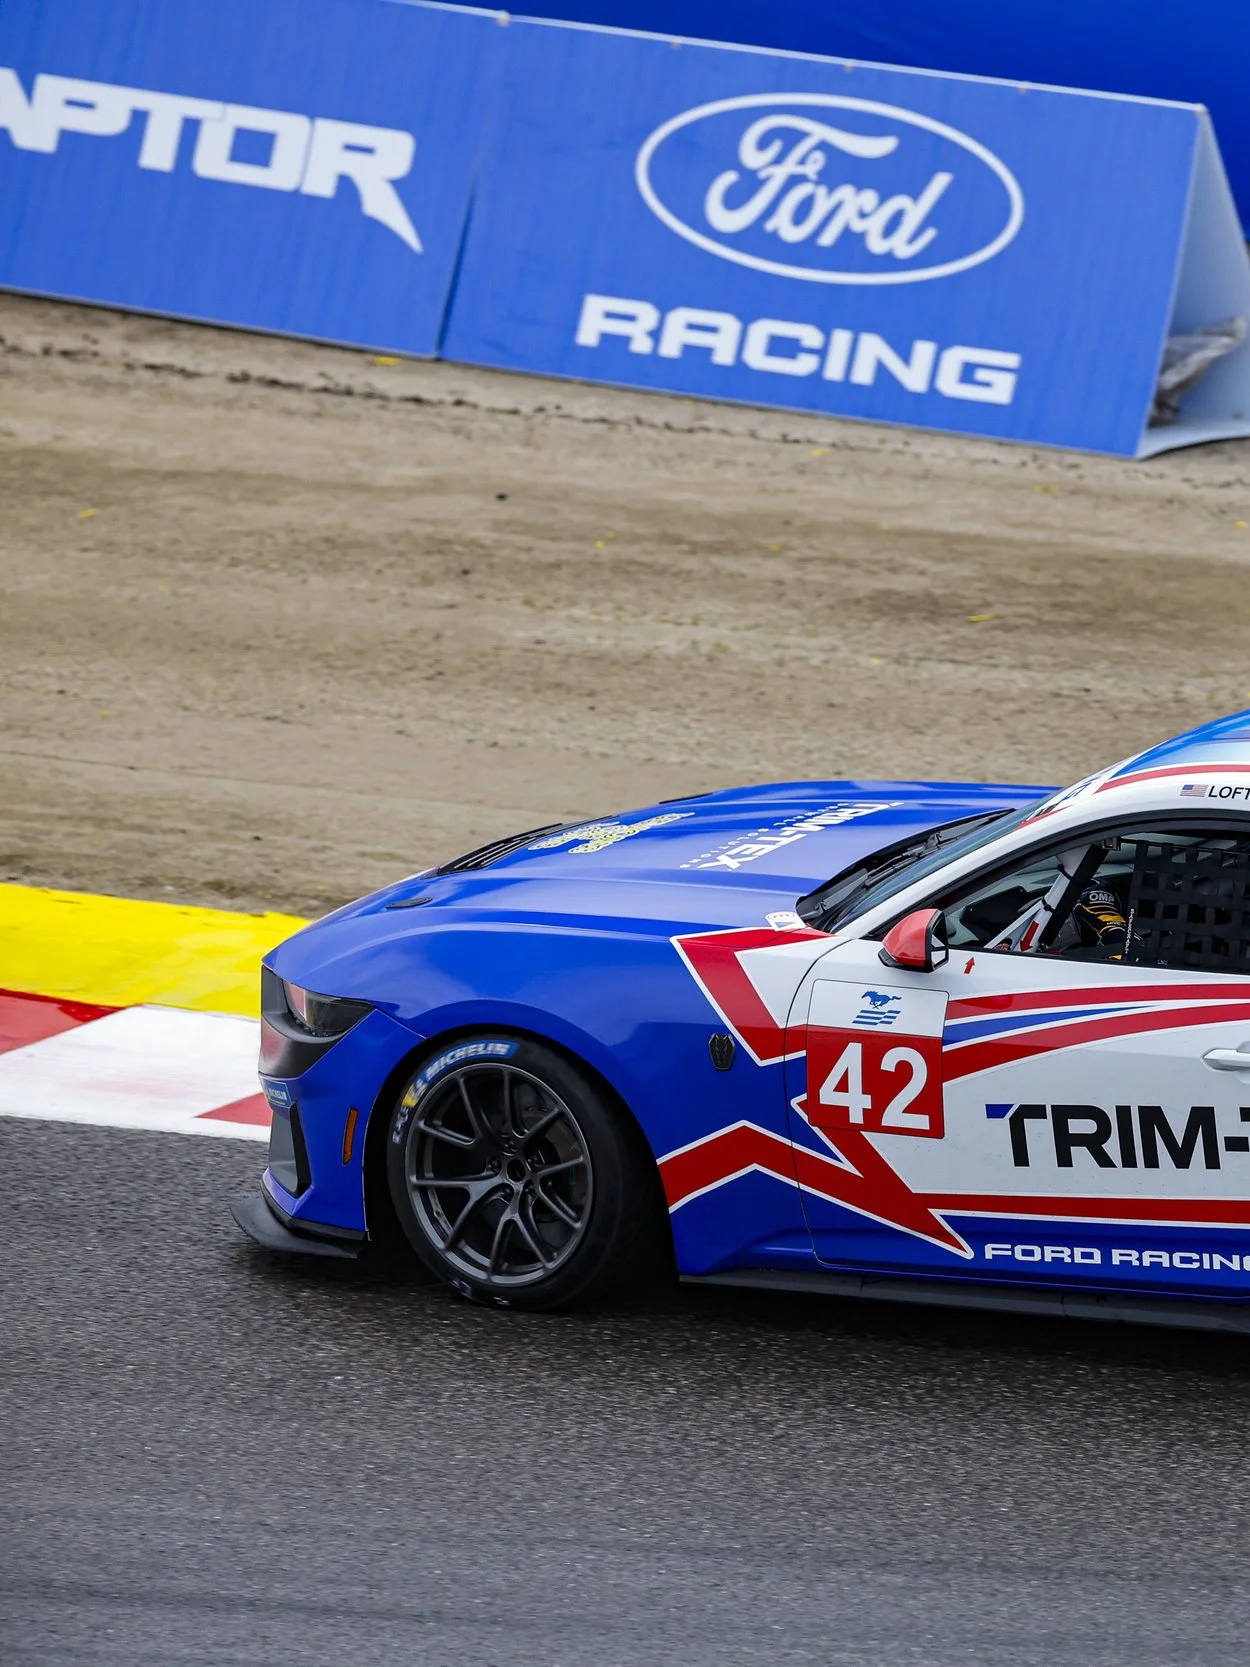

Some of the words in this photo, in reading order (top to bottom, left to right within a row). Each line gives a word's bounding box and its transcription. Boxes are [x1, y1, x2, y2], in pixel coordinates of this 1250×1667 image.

[705, 114, 954, 259] Ford
[575, 294, 1022, 405] RACING
[697, 802, 904, 870] TRIM-TEX
[425, 1042, 511, 1082] MICHELIN
[819, 1042, 930, 1131] 42
[984, 1243, 1101, 1264] FORD
